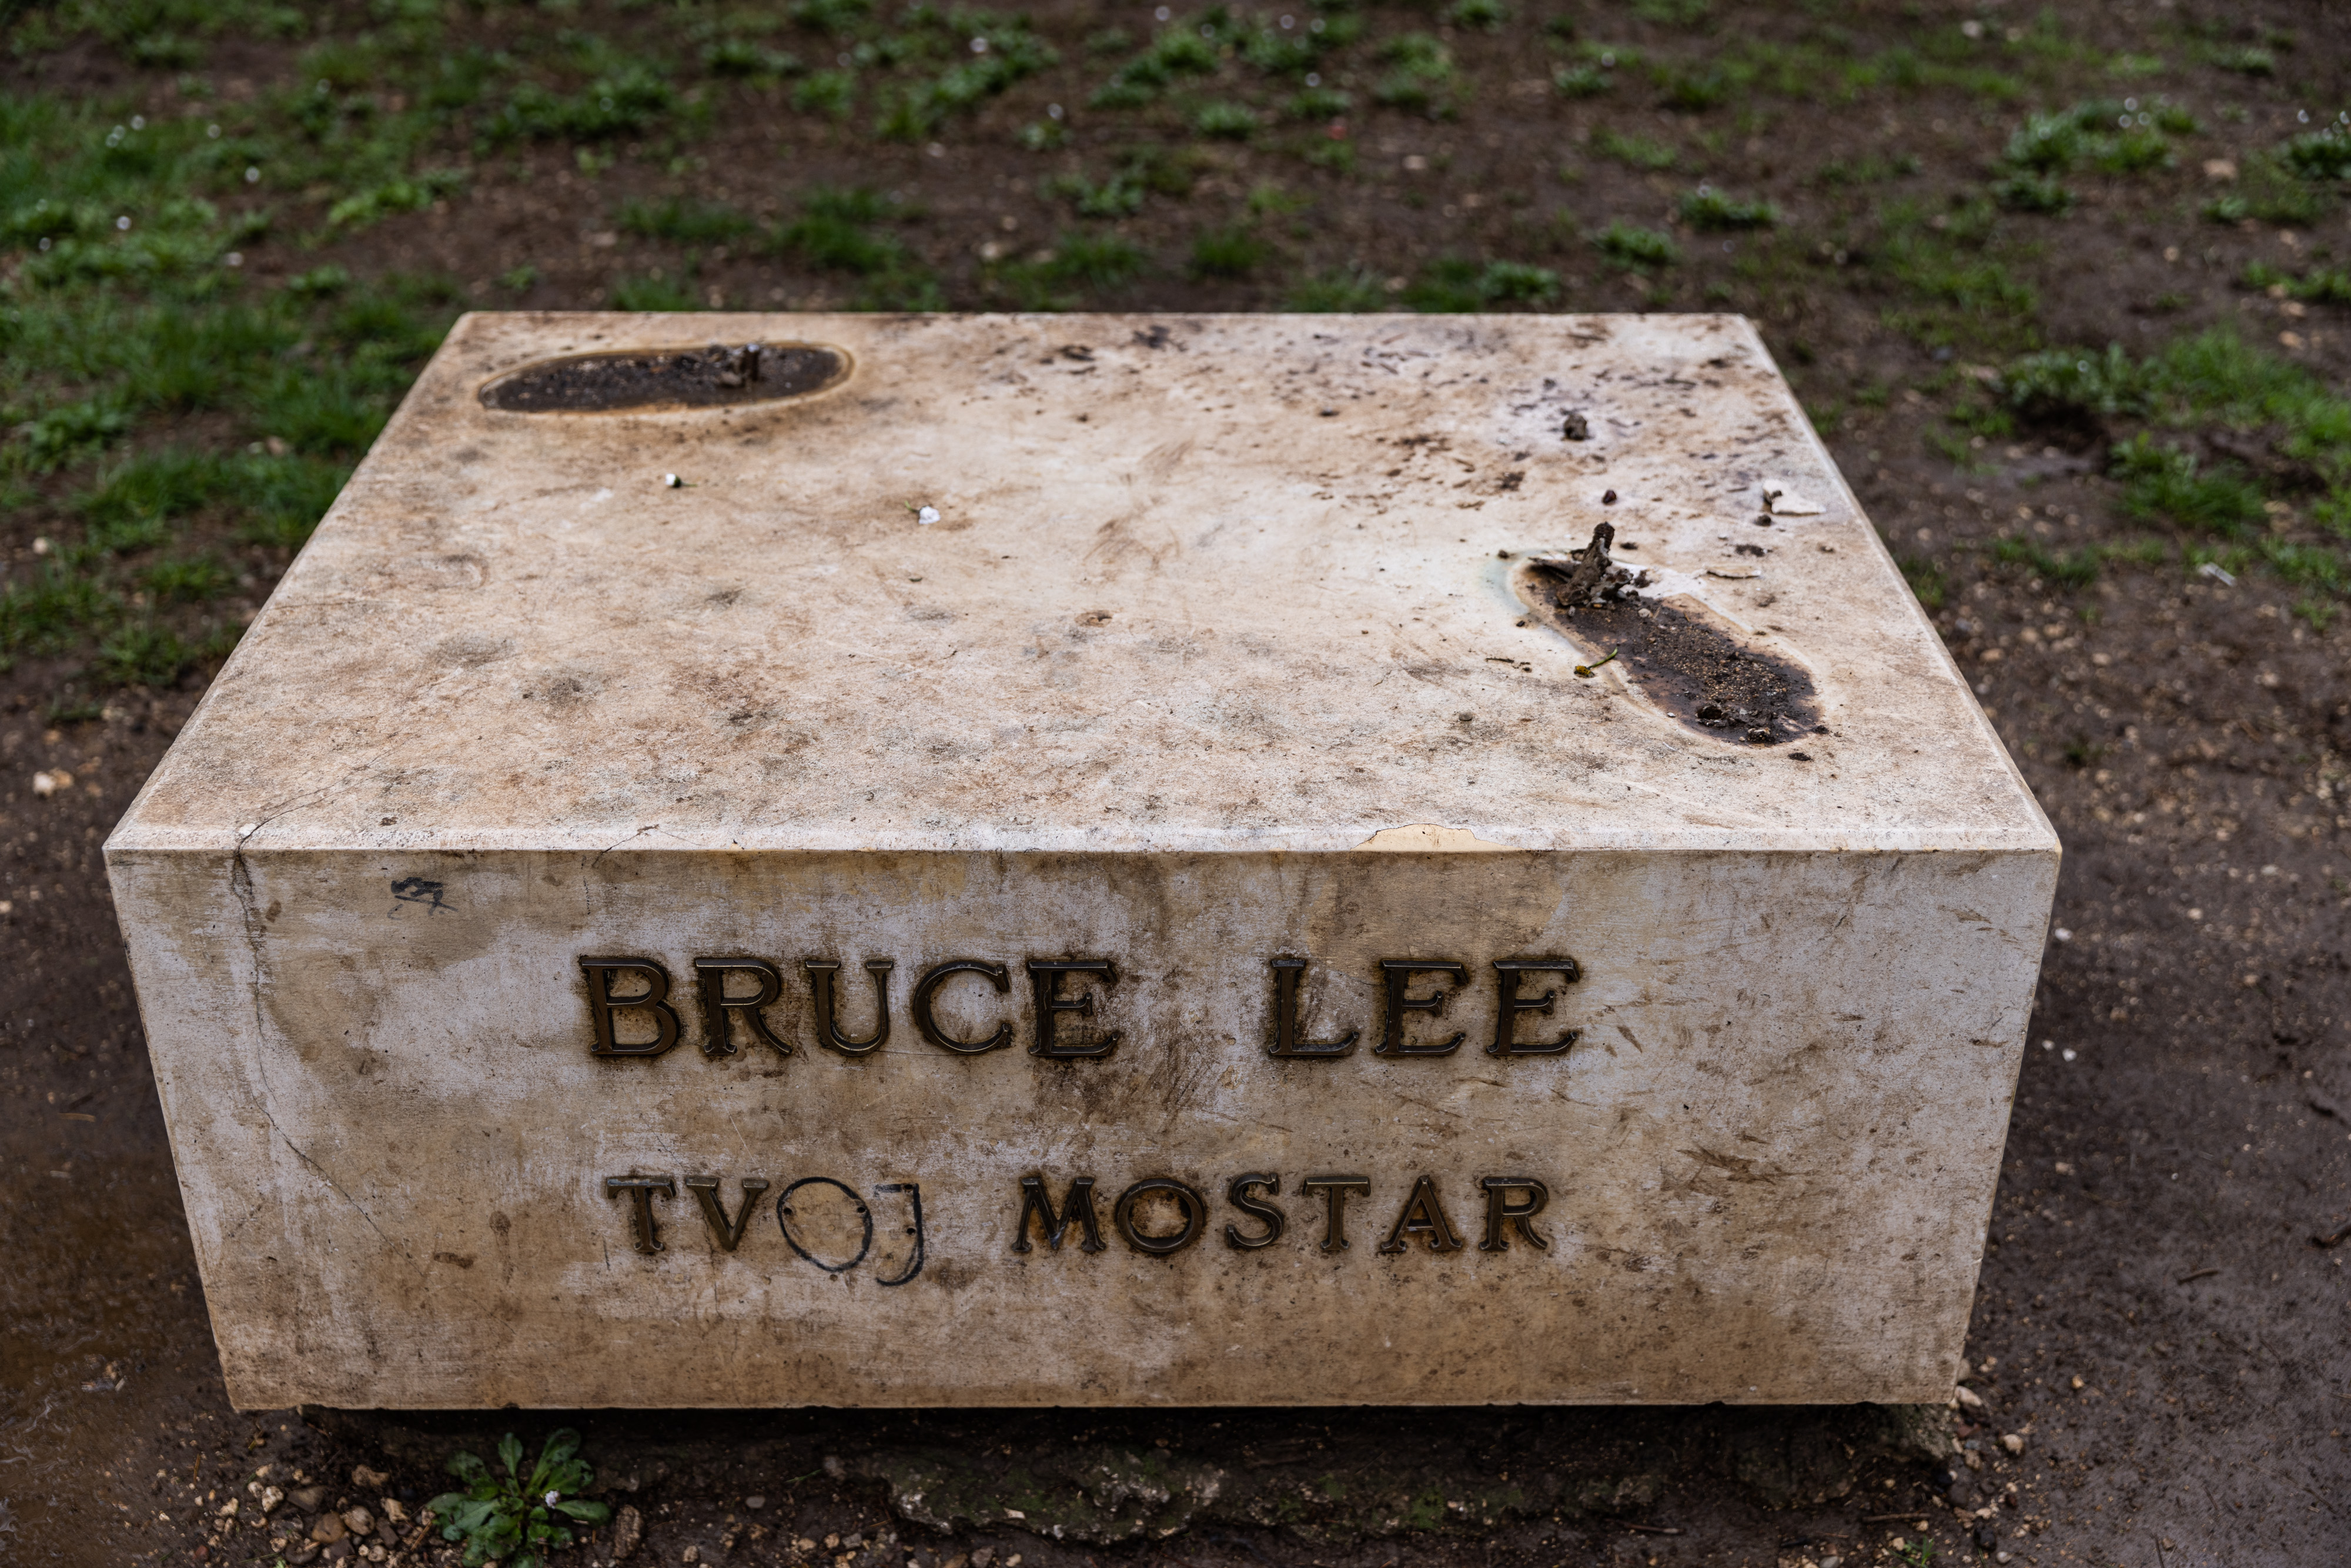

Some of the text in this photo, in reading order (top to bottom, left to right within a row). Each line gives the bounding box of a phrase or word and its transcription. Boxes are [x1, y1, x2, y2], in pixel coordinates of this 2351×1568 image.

[580, 957, 1581, 1057] BRUCE LEE
[606, 1175, 1549, 1286] TVOJ MOSTAR
